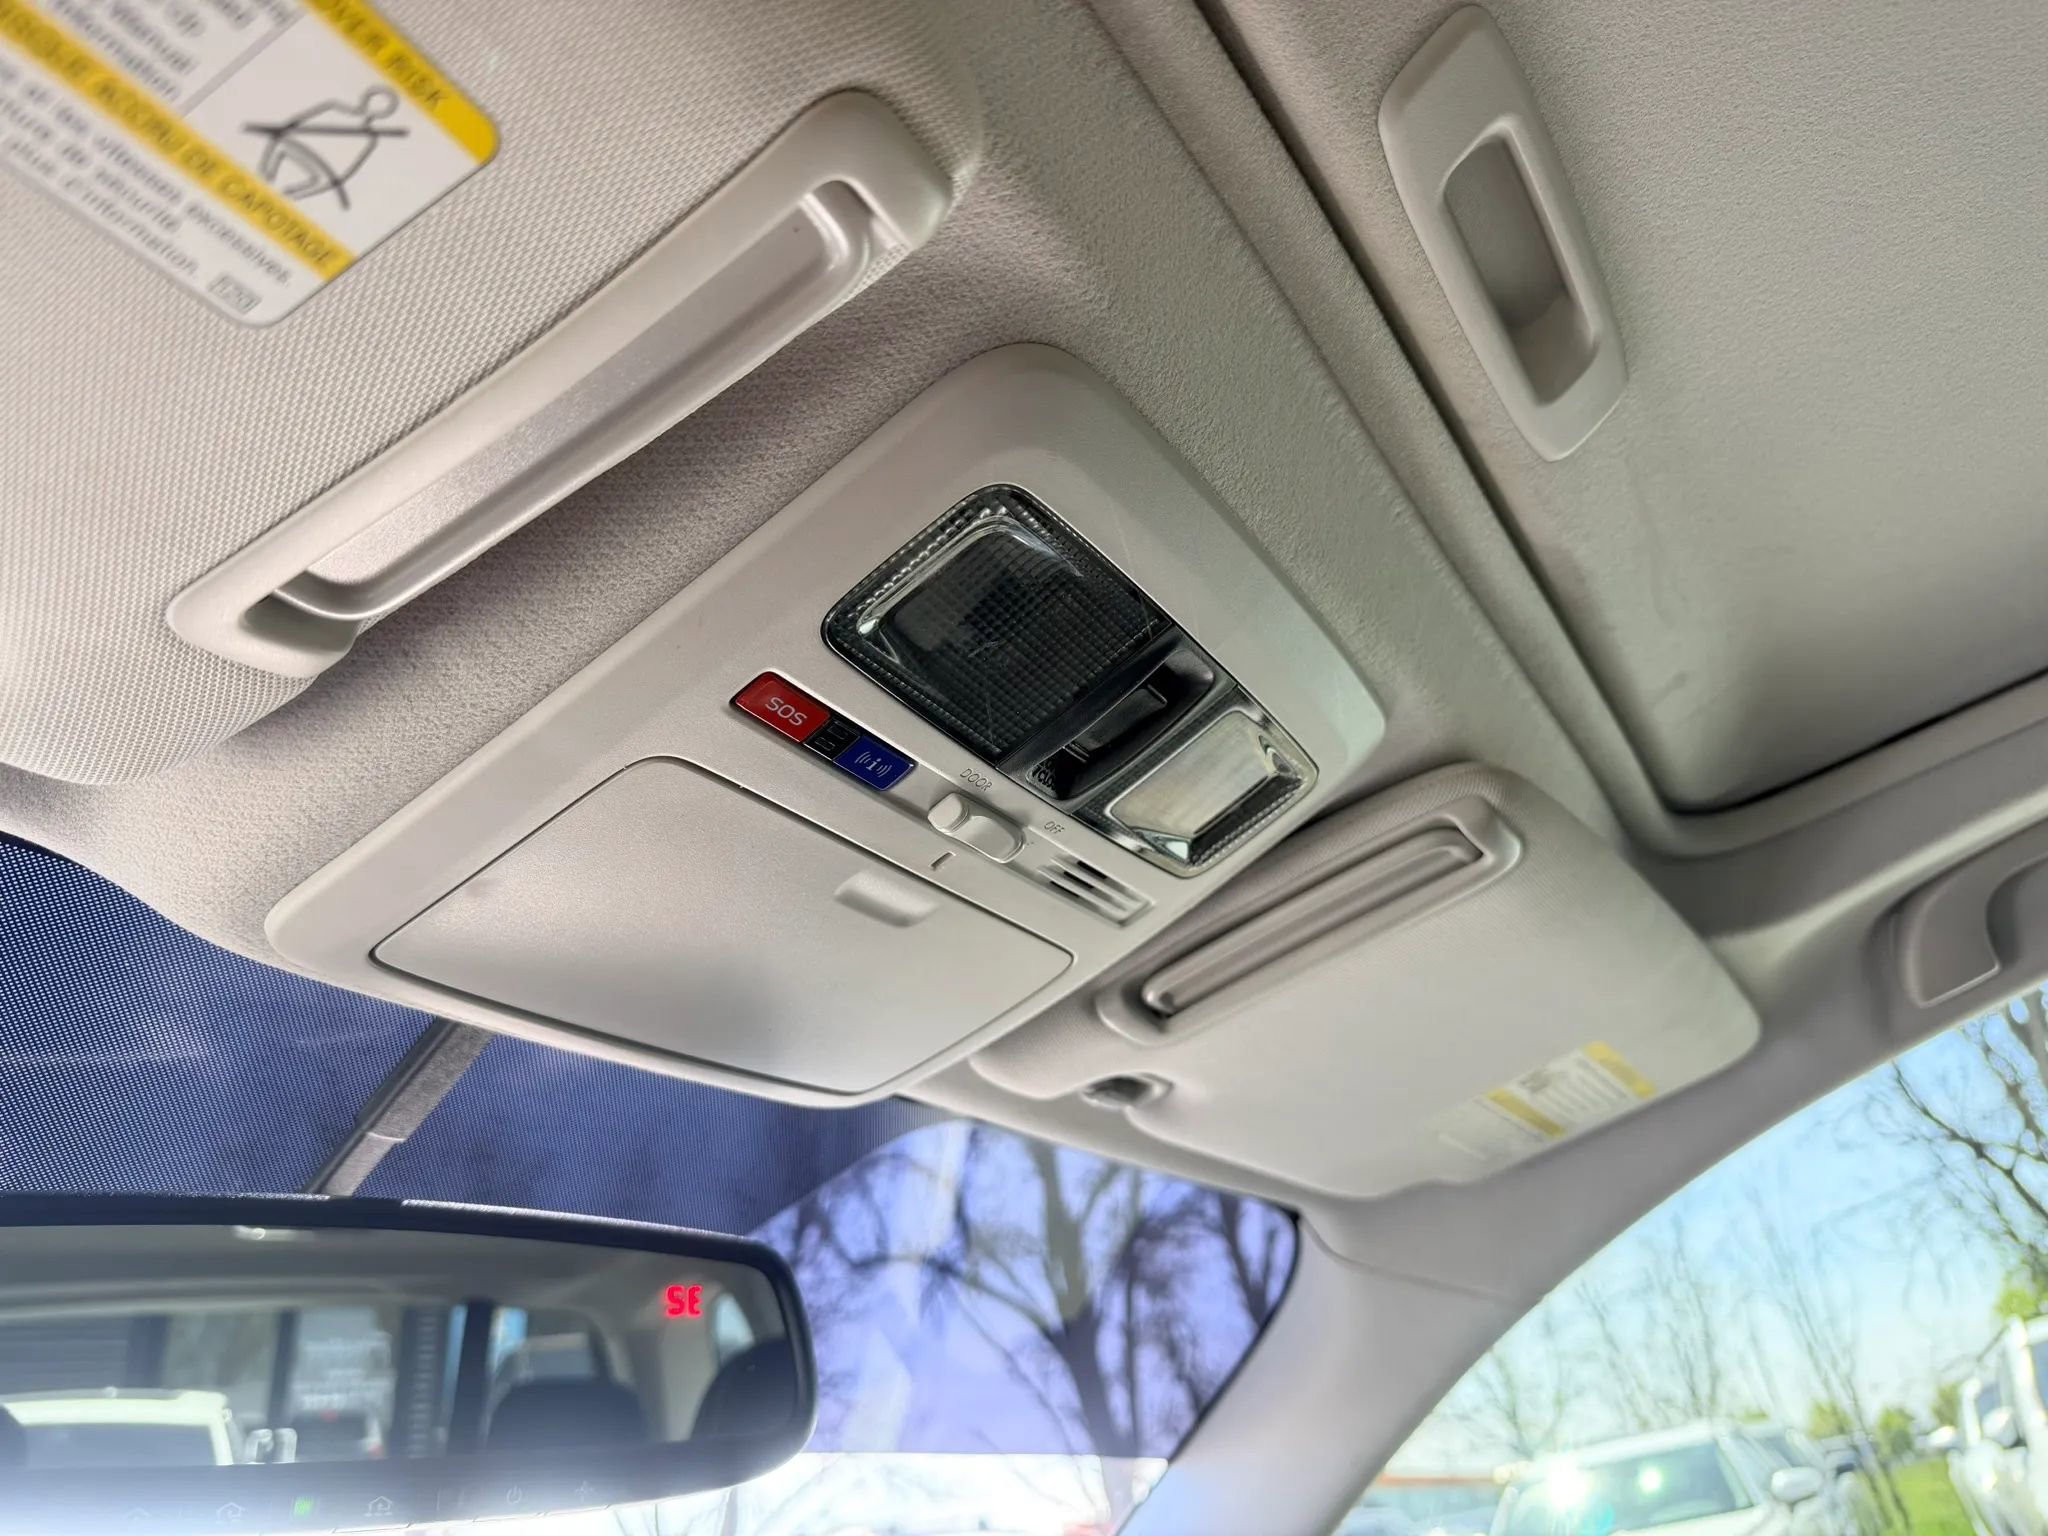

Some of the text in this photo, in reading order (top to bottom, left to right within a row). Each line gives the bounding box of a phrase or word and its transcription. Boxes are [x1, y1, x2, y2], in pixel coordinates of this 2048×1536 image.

[384, 53, 448, 111] RISK
[215, 174, 334, 266] CAPOTAGE
[765, 697, 808, 726] SOS
[960, 768, 993, 791] DOOR
[1044, 820, 1065, 834] OFF
[666, 1284, 703, 1317] SE
